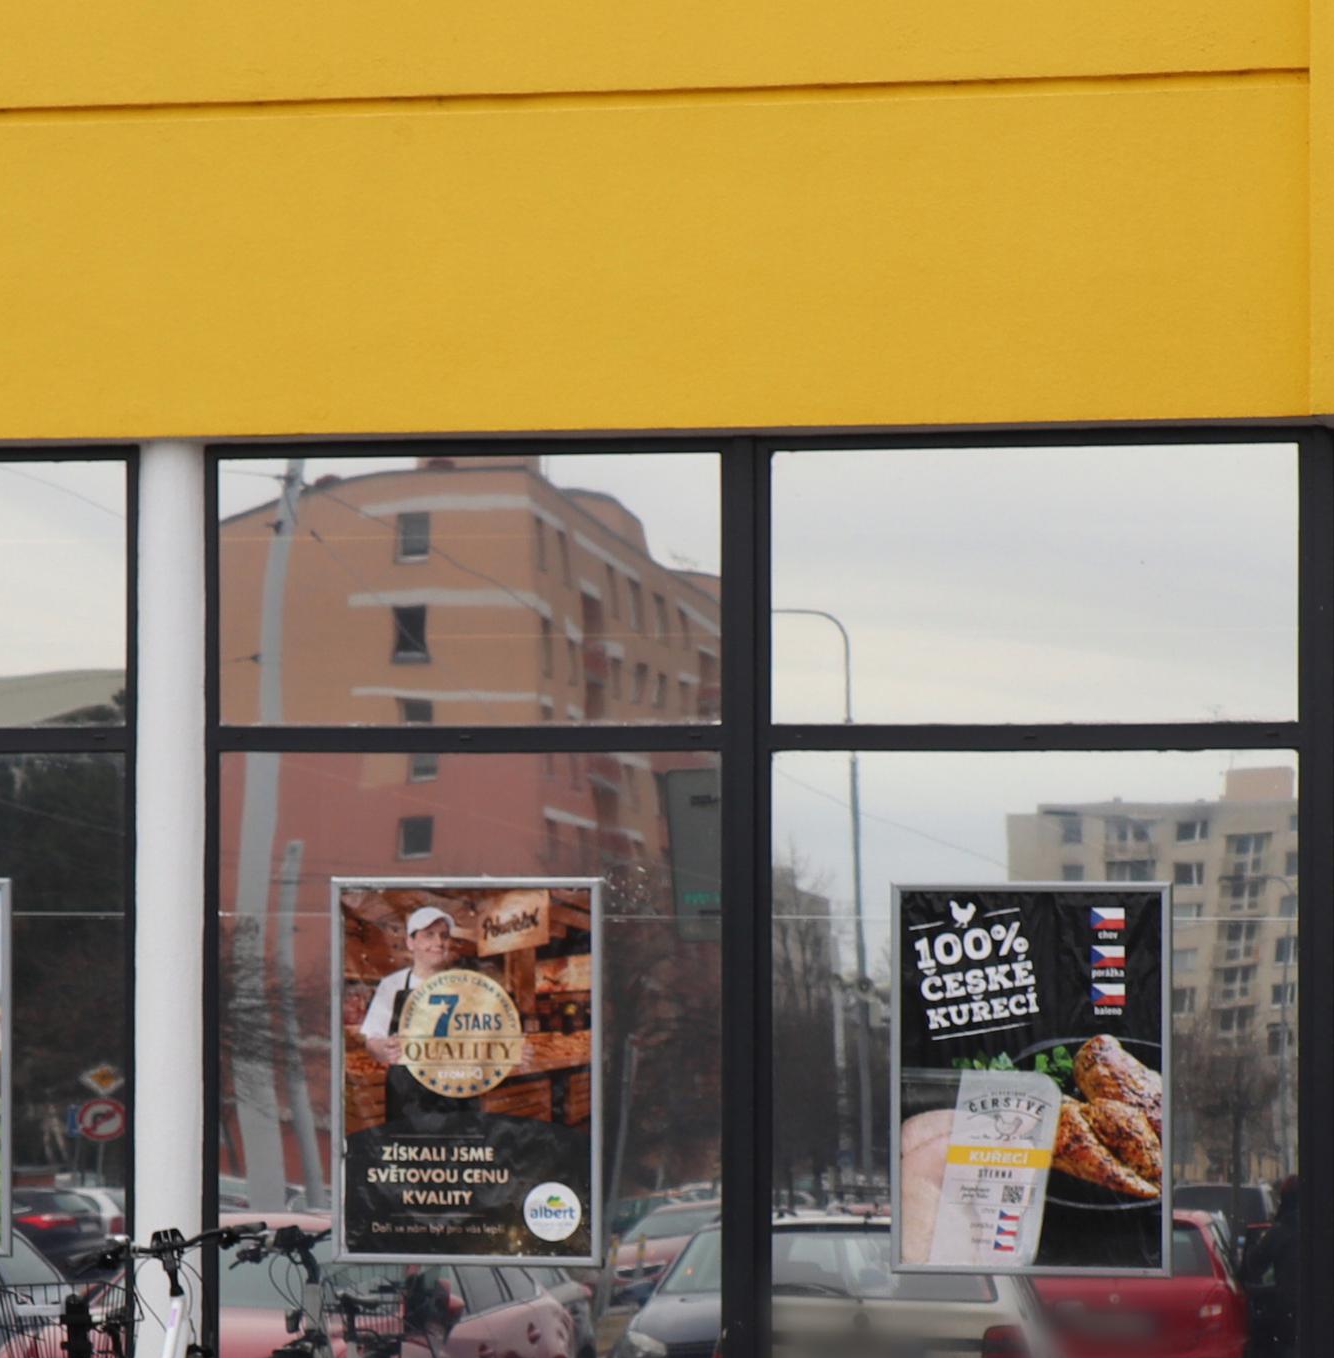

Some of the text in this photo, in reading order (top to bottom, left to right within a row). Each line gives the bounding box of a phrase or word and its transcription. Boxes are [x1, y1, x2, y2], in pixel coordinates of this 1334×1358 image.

[1097, 929, 1119, 940] chov
[913, 921, 1030, 972] 100%
[919, 953, 1037, 1002] ČESKÉ
[1091, 967, 1126, 980] porážka
[428, 994, 503, 1037] 7 STARS
[925, 985, 1041, 1031] KUŘECÍ
[1093, 1006, 1123, 1016] baleno
[405, 1041, 516, 1062] QUALITY
[967, 1095, 1046, 1116] ČERSTVÉ
[381, 1143, 495, 1162] ZÍSKALI JSME
[367, 1163, 509, 1184] SVĚTOVOU CENU
[402, 1189, 473, 1206] KVALITY
[529, 1206, 576, 1220] albert
